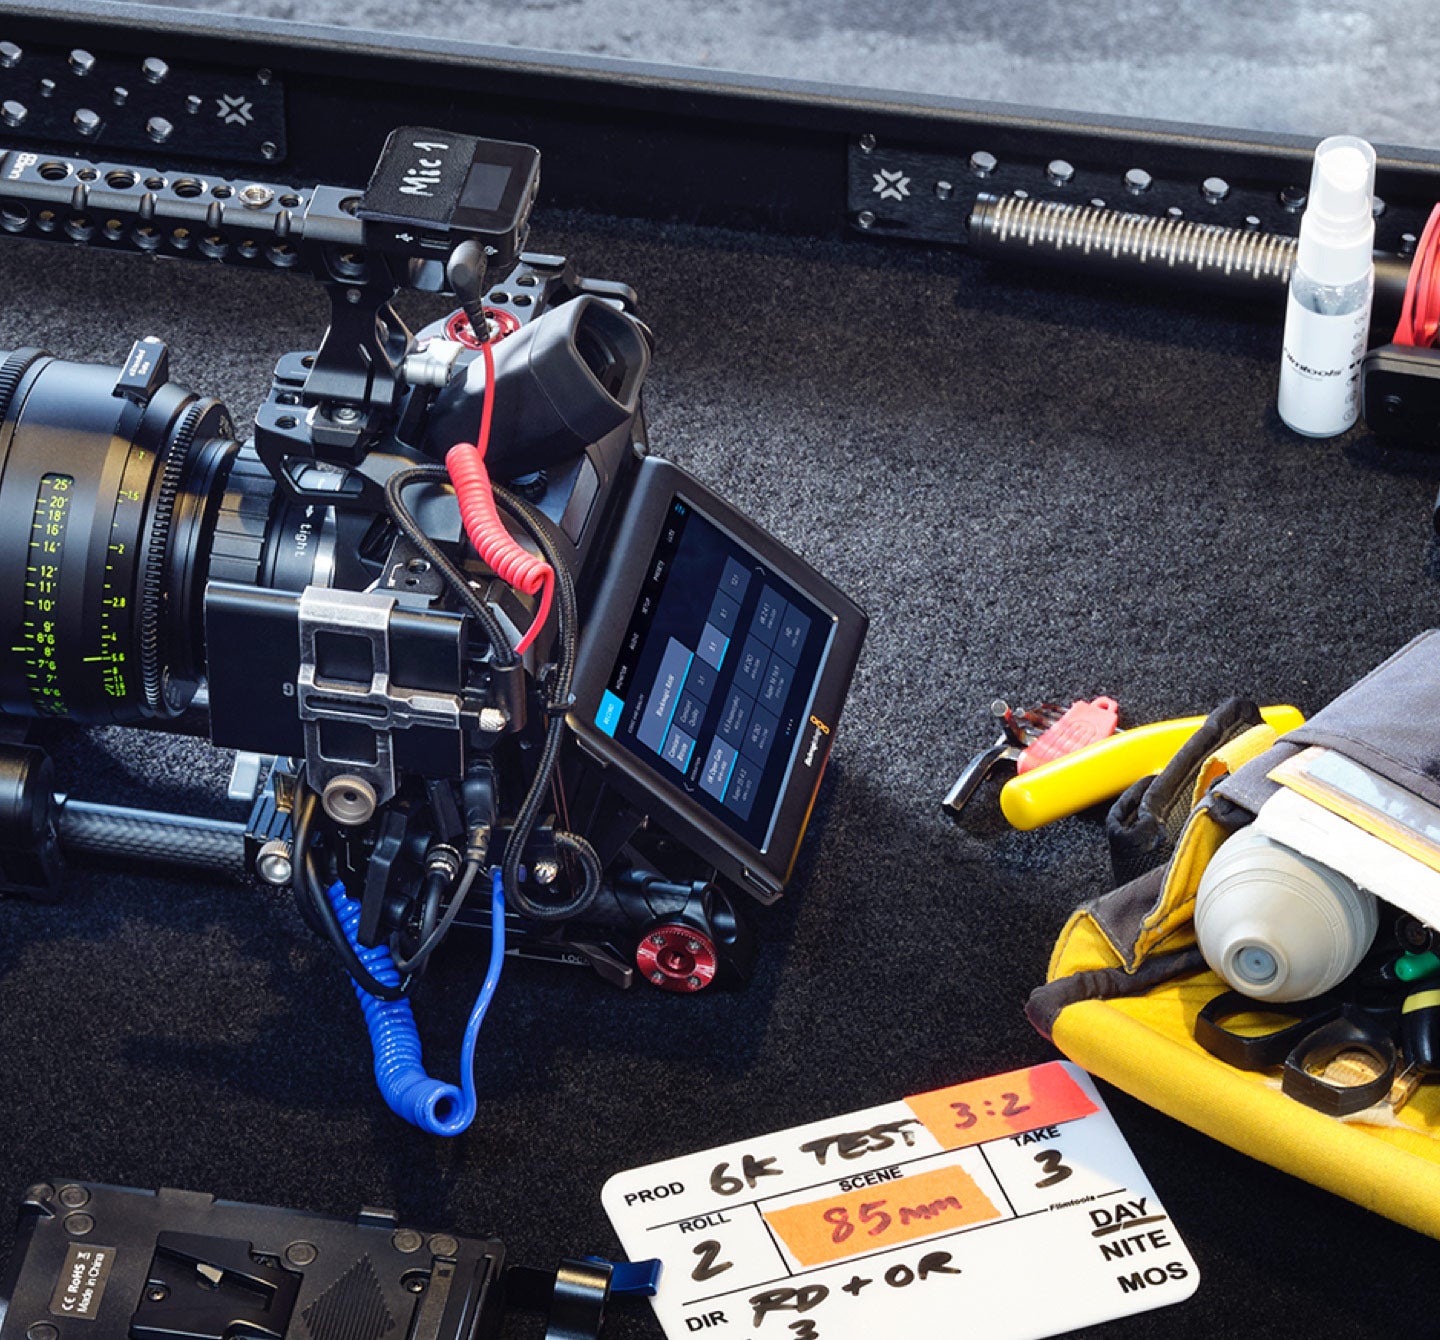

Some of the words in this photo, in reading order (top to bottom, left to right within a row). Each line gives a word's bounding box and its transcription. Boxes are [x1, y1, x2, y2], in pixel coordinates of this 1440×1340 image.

[413, 142, 449, 152] 1
[399, 159, 441, 196] Mic
[118, 543, 125, 554] 2
[295, 523, 312, 559] tight
[950, 1092, 1031, 1130] 3:2
[1010, 1126, 1061, 1148] TAKE
[710, 1154, 784, 1196] 6K
[799, 1118, 924, 1166] TEST
[1034, 1148, 1073, 1188] 3
[624, 1181, 686, 1206] PROD
[838, 1166, 904, 1192] SCENE
[678, 1212, 732, 1234] ROLL
[1088, 1198, 1148, 1228] DAY
[1099, 1229, 1171, 1262] NITE
[88, 1253, 105, 1278] China
[691, 1239, 733, 1282] 2
[884, 1251, 962, 1288] OR
[68, 1264, 86, 1293] RoHS
[85, 1278, 96, 1286] in
[1117, 1261, 1189, 1294] MOS
[77, 1288, 94, 1313] Made
[685, 1310, 730, 1332] DIR
